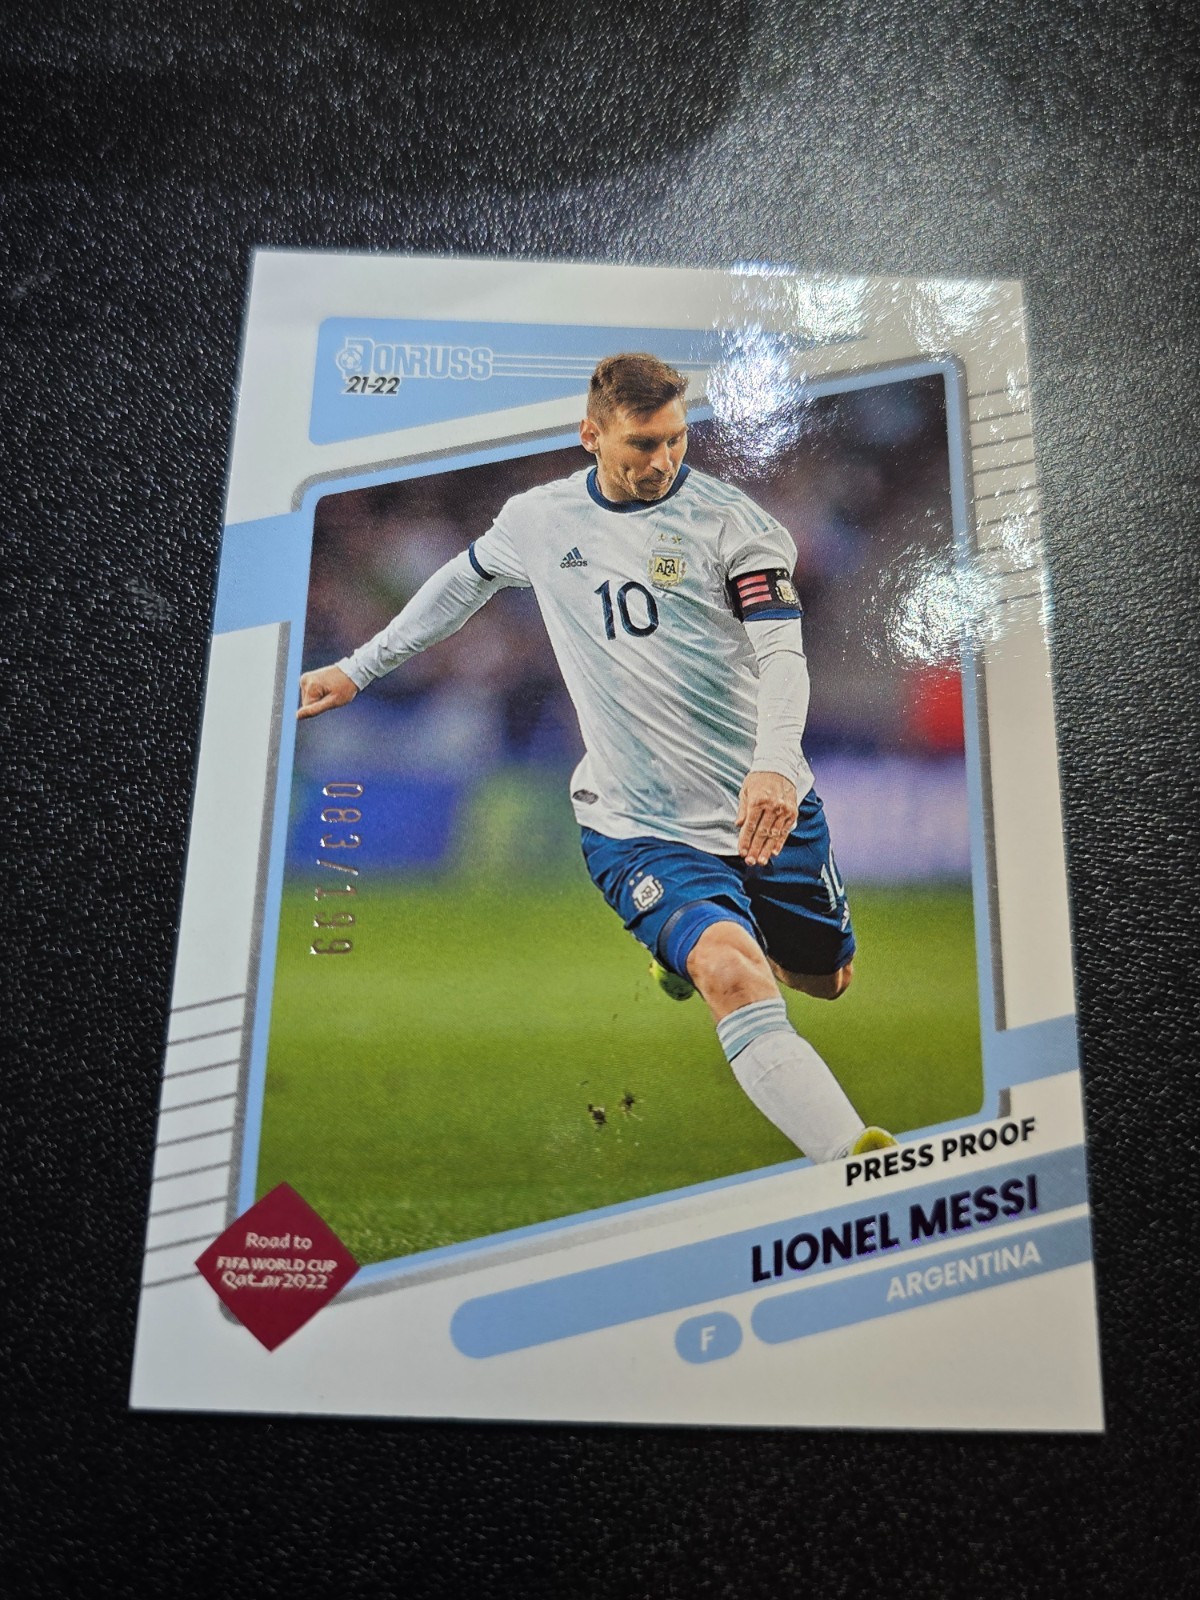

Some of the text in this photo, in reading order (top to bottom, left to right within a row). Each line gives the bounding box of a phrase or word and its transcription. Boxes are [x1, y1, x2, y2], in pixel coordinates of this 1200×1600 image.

[336, 337, 494, 381] DONRUSS
[346, 375, 401, 395] 21-22
[560, 560, 588, 569] adidas
[655, 557, 677, 577] AFA
[594, 579, 659, 640] 10
[310, 782, 364, 955] 083/199
[846, 1117, 1036, 1187] PRESS PROOF
[245, 1231, 312, 1250] Road to
[752, 1173, 1039, 1283] LIONEL MESSI
[216, 1255, 338, 1273] FIFA WORLD CUP
[886, 1240, 1042, 1302] ARGENTINA
[700, 1325, 716, 1352] F
